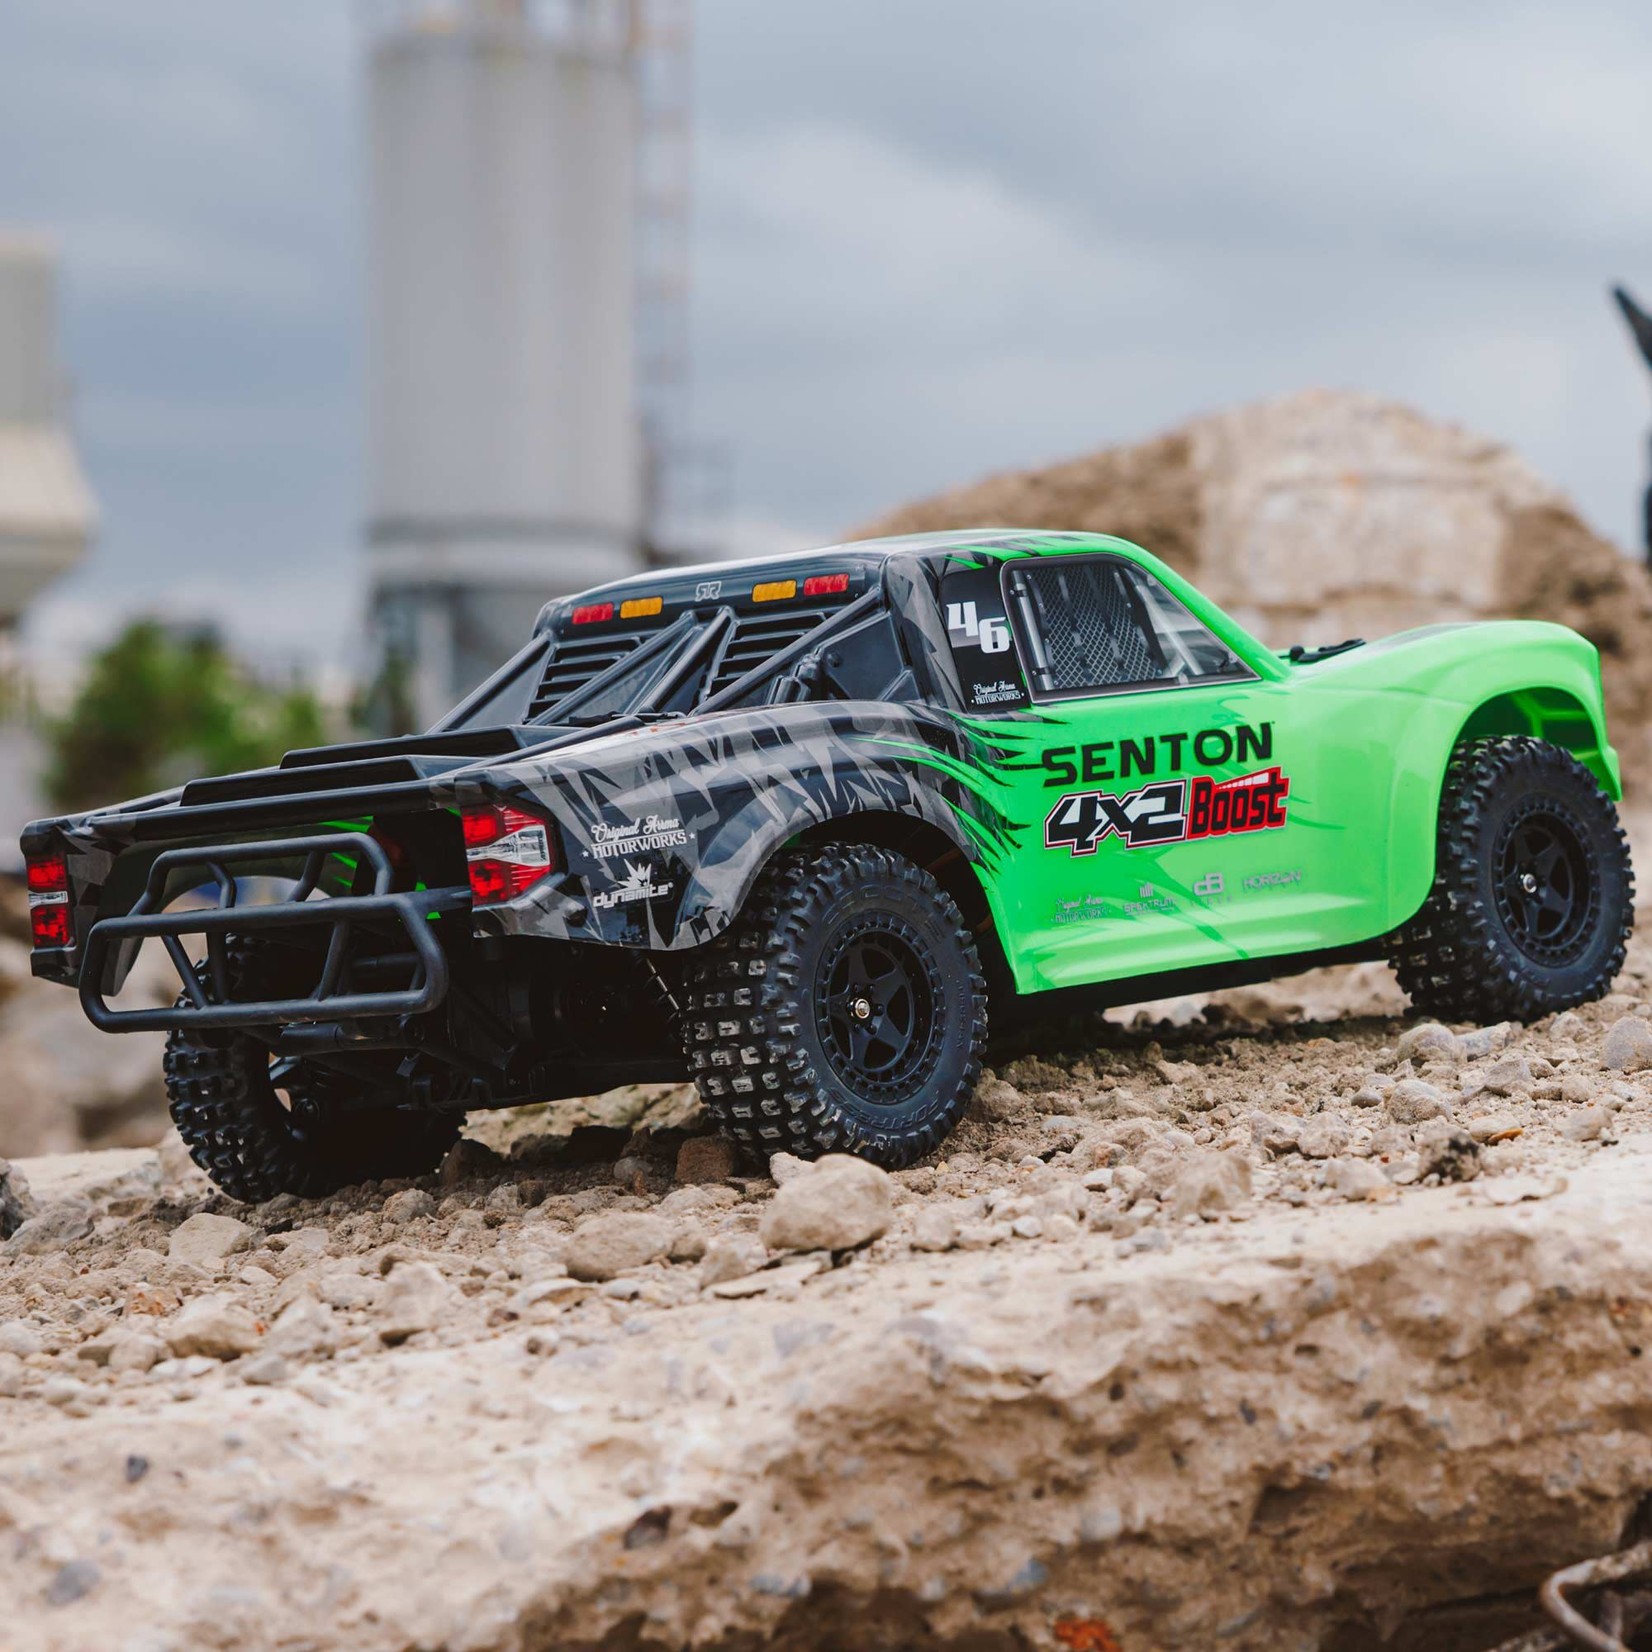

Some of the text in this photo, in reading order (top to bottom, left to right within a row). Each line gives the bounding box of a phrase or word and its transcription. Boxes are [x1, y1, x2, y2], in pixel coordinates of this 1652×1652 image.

[946, 601, 1010, 653] 46
[1042, 722, 1272, 787] SENTON
[591, 817, 640, 843] Original
[1045, 769, 1288, 855] 4x2 Boost
[591, 832, 687, 859] MOTORWORKS
